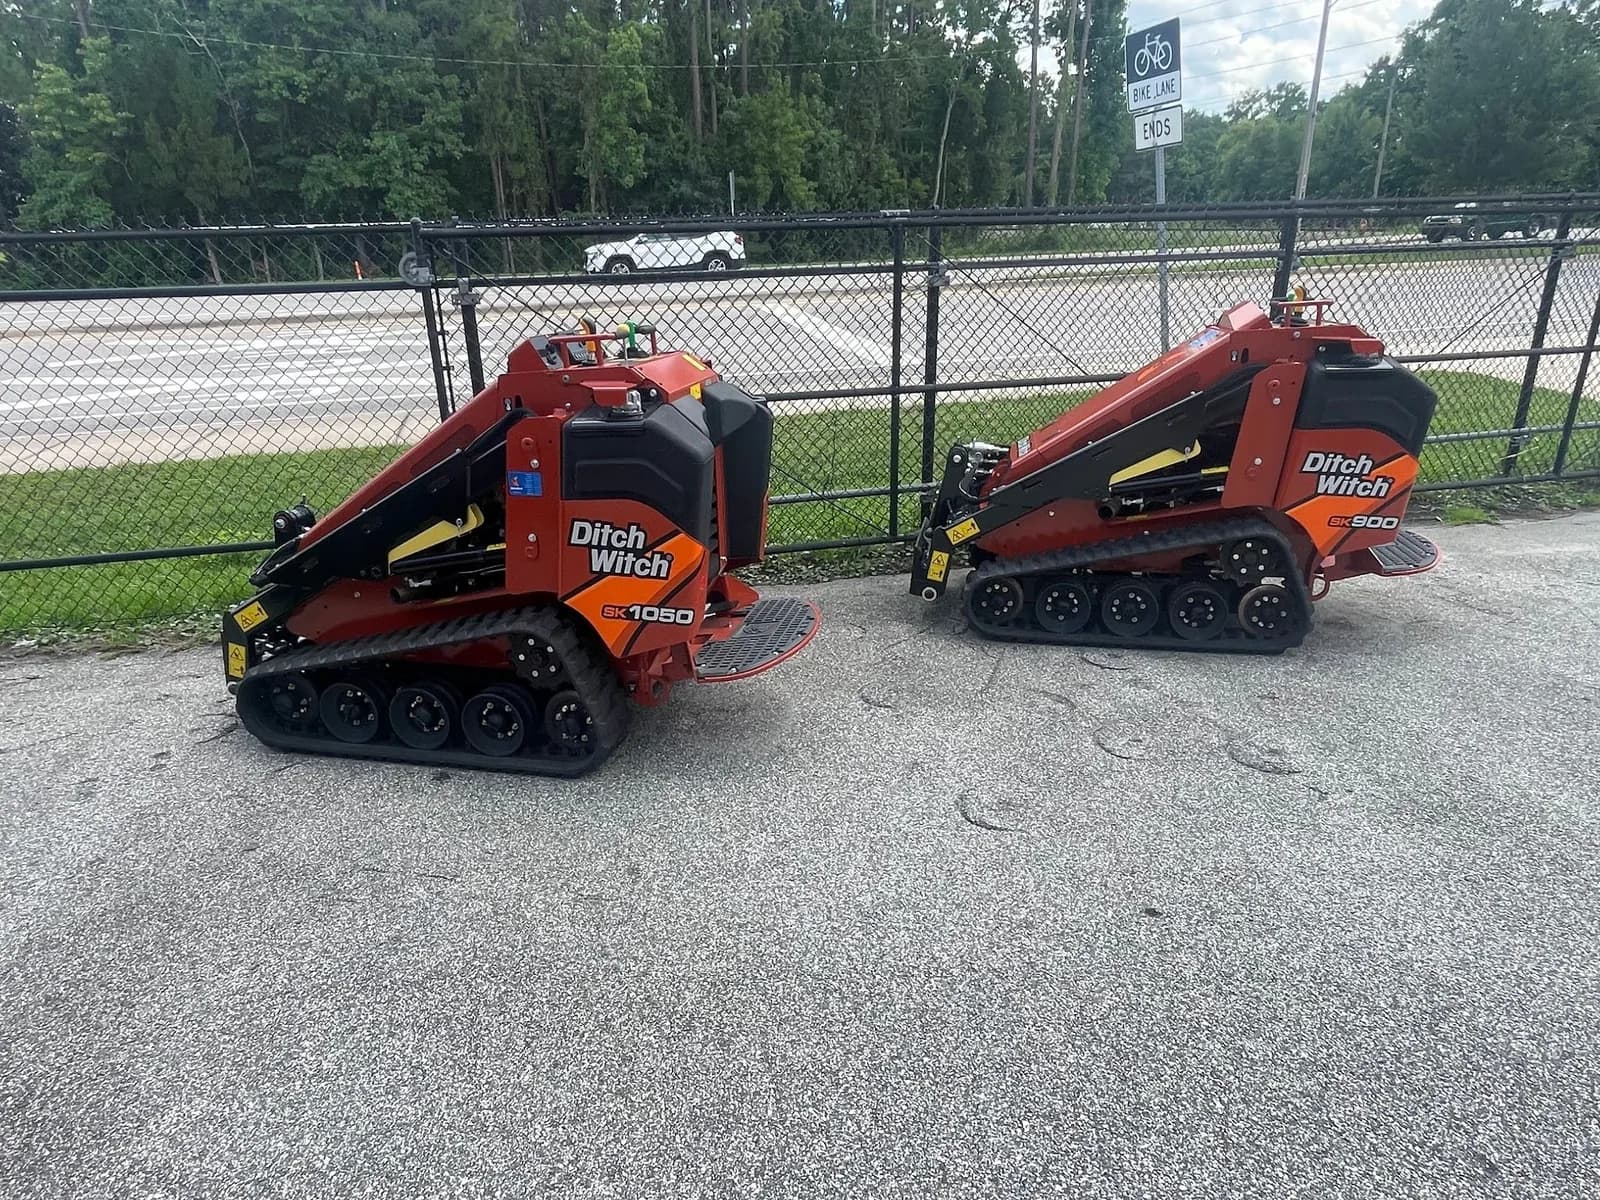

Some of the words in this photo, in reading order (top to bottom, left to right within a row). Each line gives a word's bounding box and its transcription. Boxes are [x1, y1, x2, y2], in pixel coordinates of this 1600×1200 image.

[1133, 85, 1151, 103] BIKE
[1155, 78, 1176, 98] LANE
[1143, 118, 1171, 140] ENDS
[1302, 453, 1373, 474] Ditch
[1317, 475, 1390, 497] Witch
[1329, 516, 1399, 529] SK900
[570, 521, 645, 549] Ditch
[591, 549, 669, 577] Witch
[602, 605, 694, 624] SK1050
